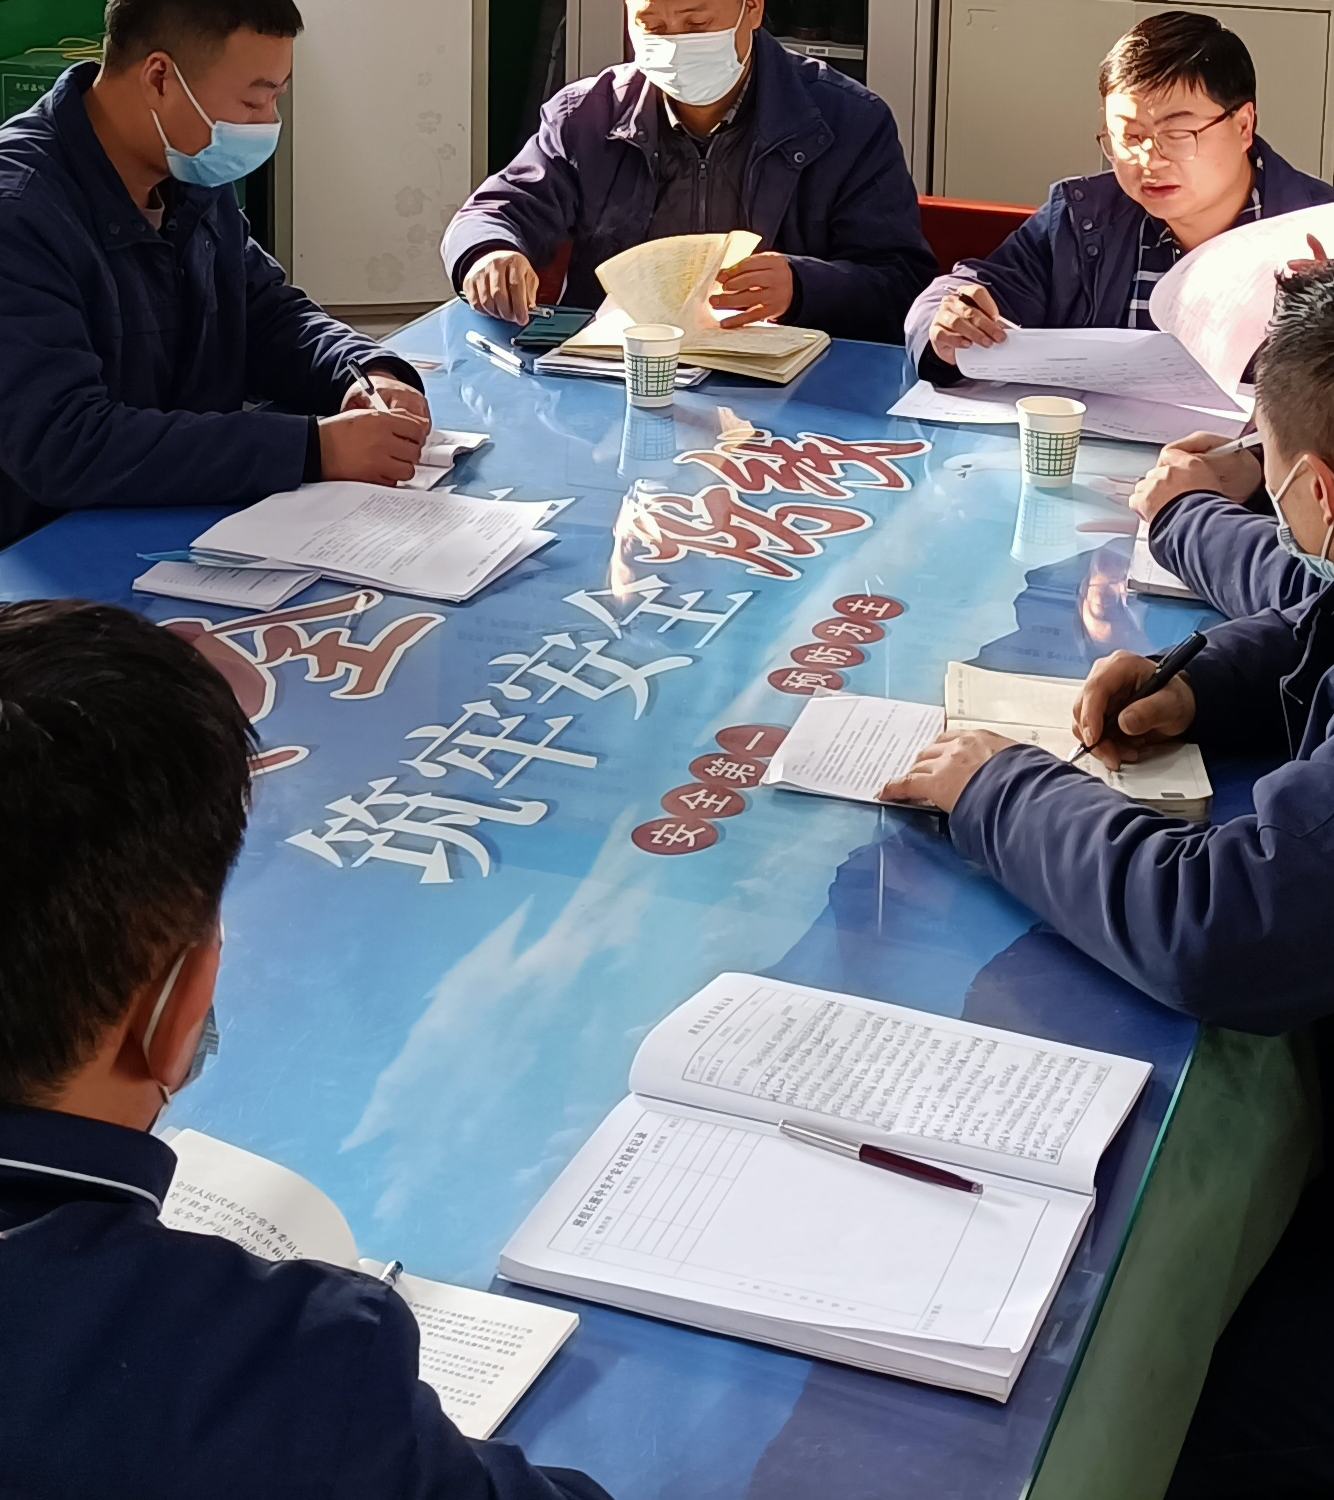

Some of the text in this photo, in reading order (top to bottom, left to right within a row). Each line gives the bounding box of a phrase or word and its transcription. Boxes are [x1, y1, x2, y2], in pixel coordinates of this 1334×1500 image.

[785, 594, 894, 694] 预防为主
[646, 728, 771, 855] 安全第一
